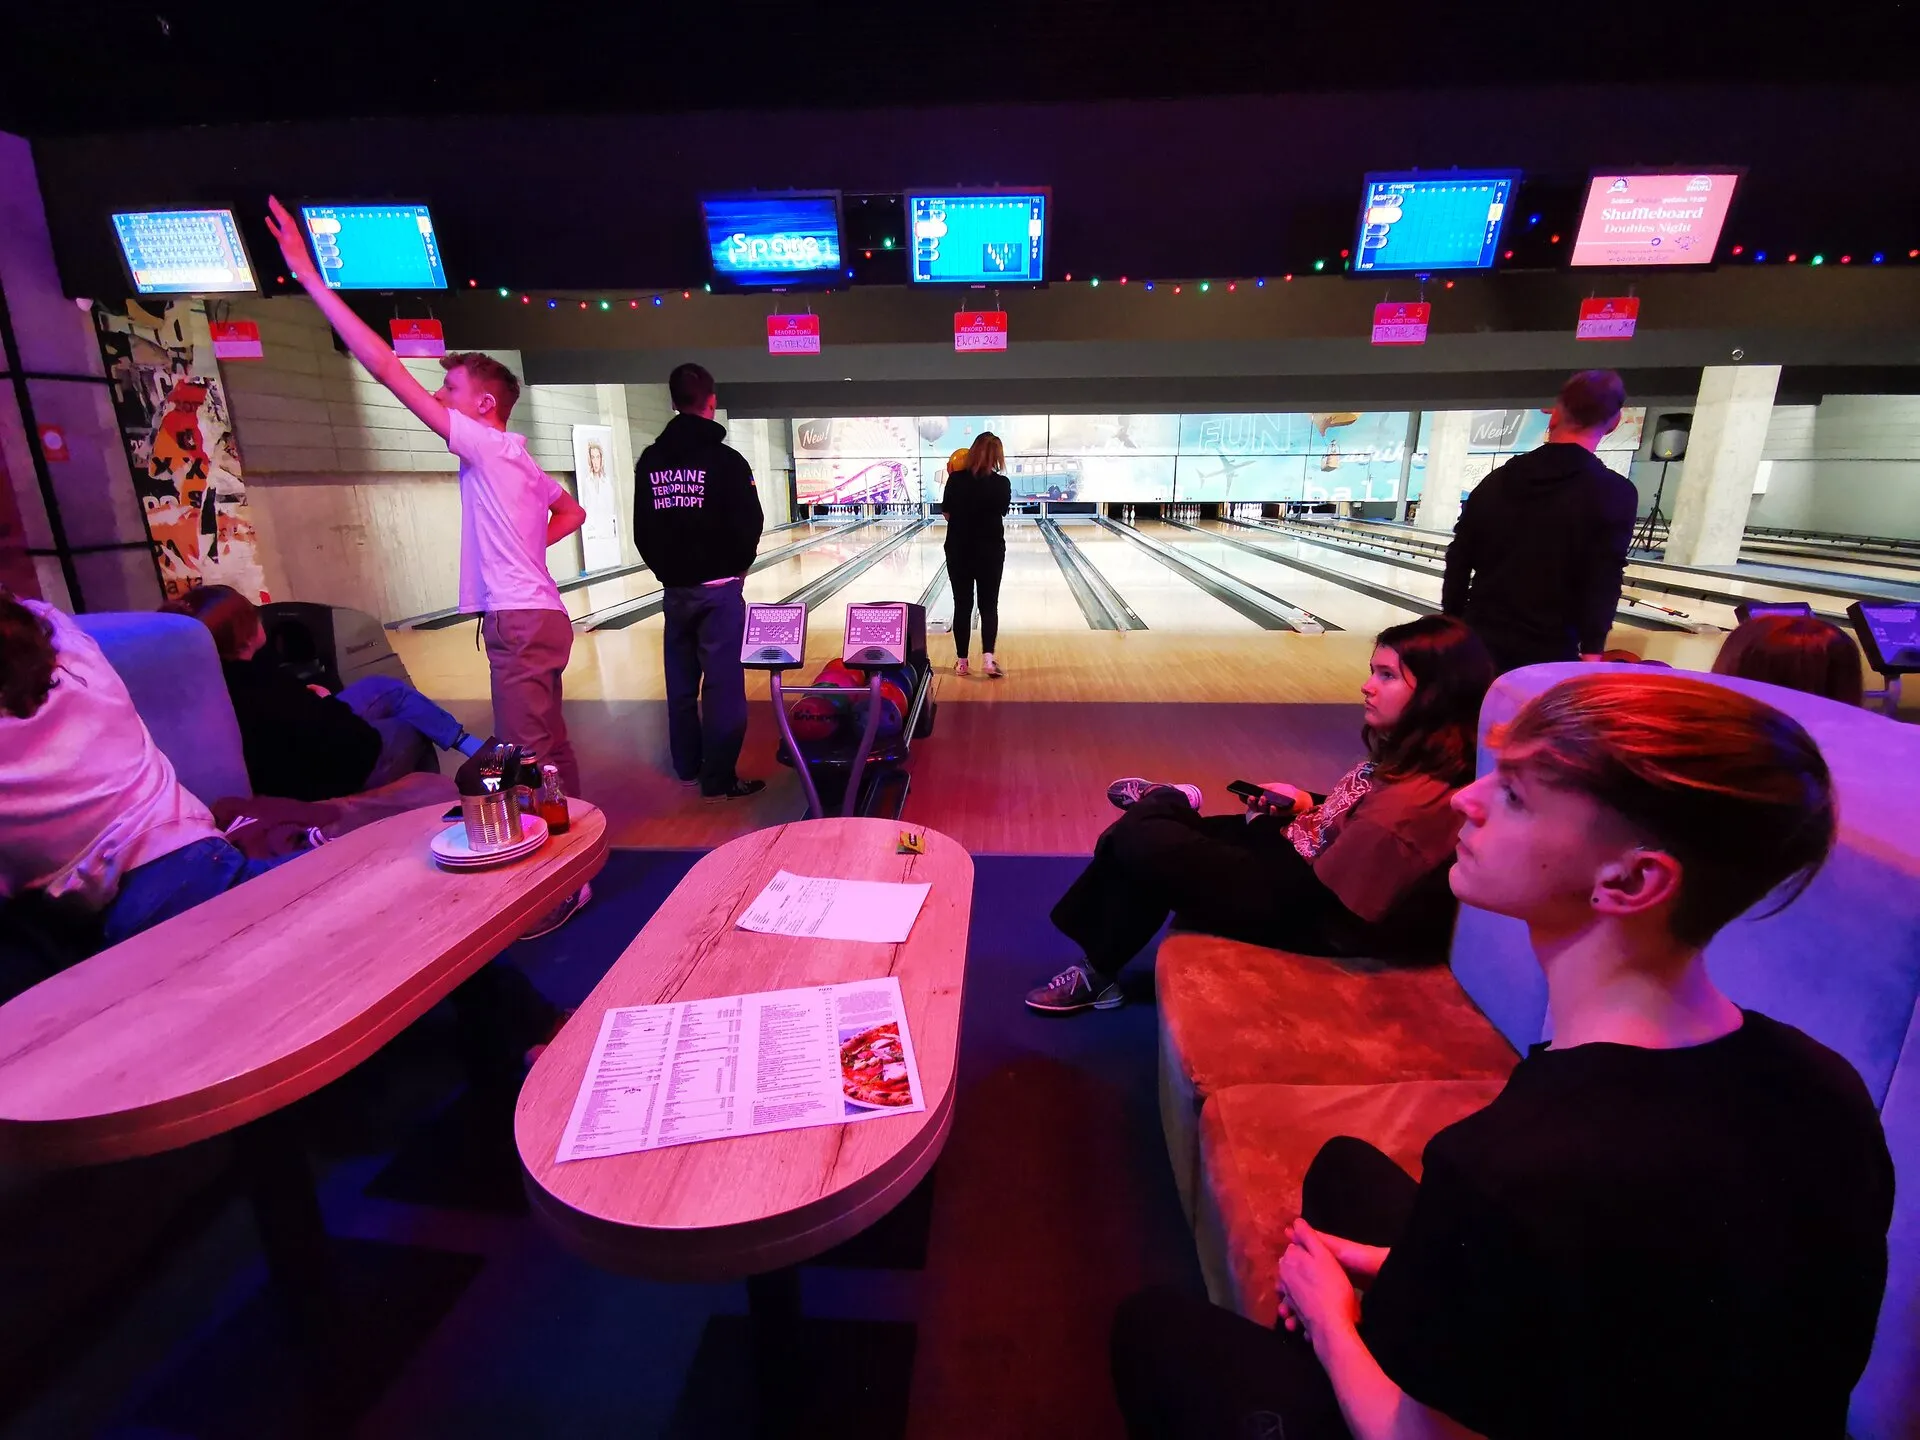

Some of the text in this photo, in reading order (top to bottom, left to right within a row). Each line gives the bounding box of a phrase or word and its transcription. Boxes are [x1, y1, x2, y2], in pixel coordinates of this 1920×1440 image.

[1600, 205, 1704, 221] Shuffleboard
[1604, 222, 1692, 236] Doubles Night
[733, 232, 820, 260] Spare
[802, 420, 832, 447] New!
[1199, 413, 1292, 452] FUN
[1472, 414, 1521, 443] New!
[650, 469, 706, 485] UKRAINE
